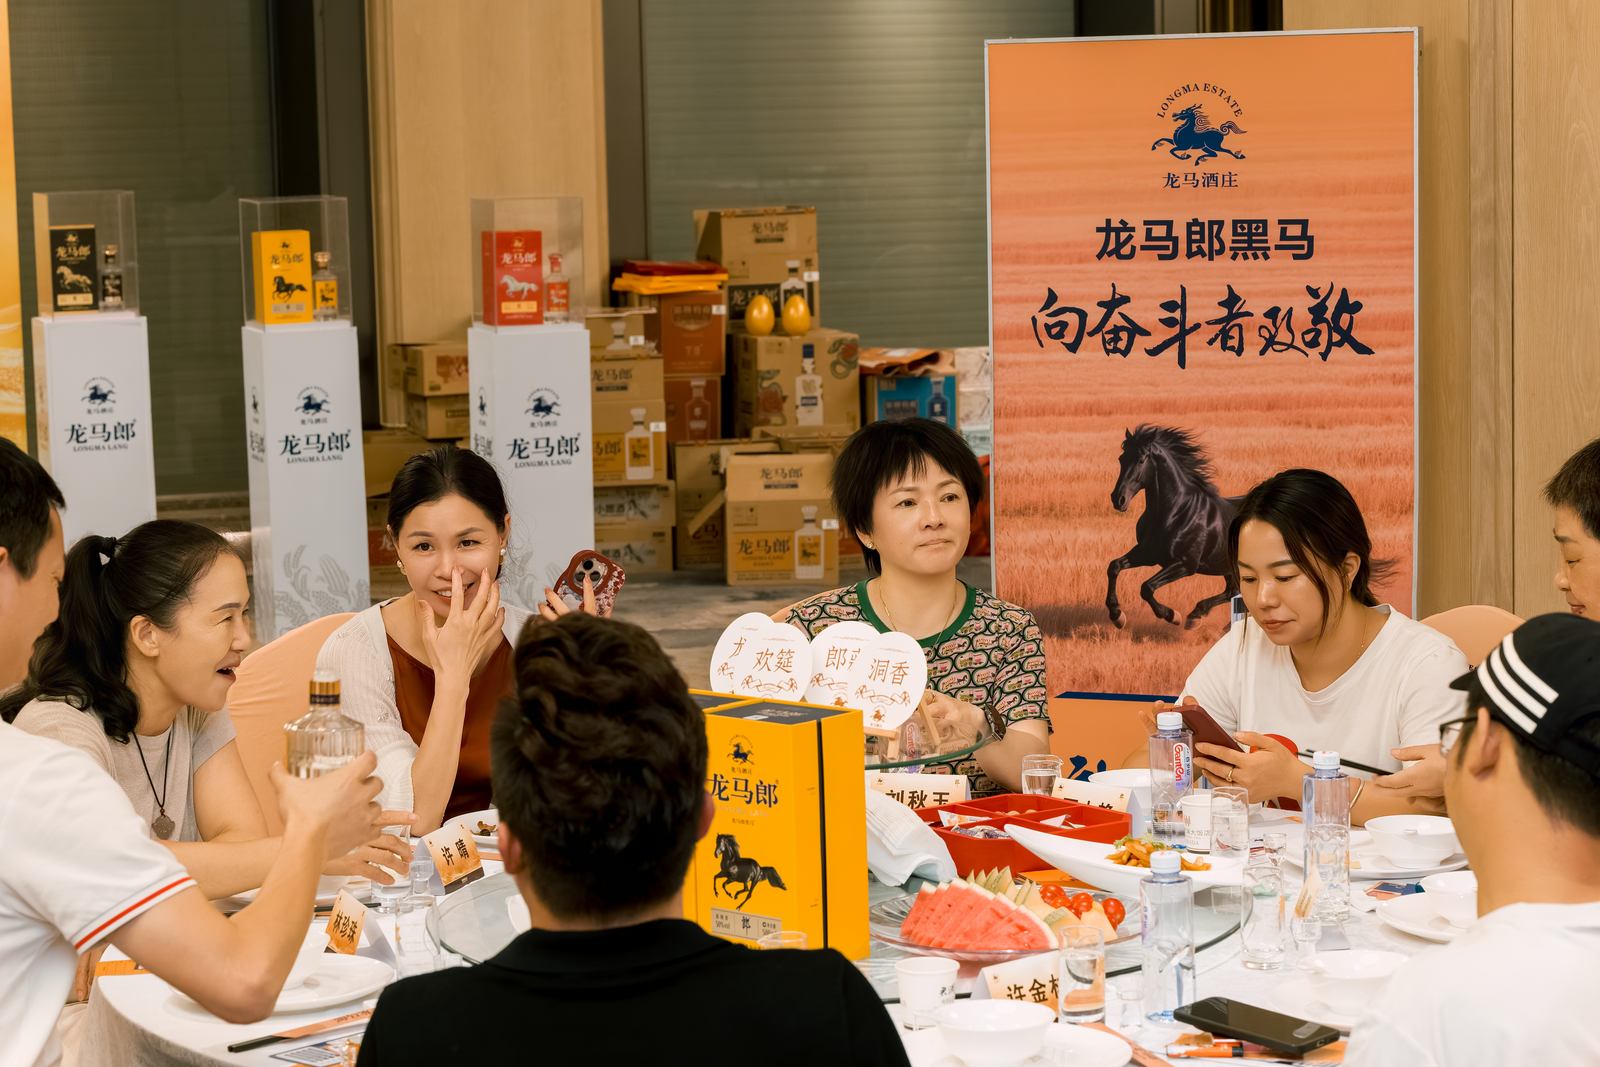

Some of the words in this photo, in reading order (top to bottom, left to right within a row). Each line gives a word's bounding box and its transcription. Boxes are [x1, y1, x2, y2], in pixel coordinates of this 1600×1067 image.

[1157, 83, 1200, 119] LONGMA
[1203, 83, 1243, 118] ESTATE
[1162, 172, 1238, 188] 龙马酒庄
[1095, 218, 1315, 261] 龙马郎黑马
[1031, 281, 1376, 370] 向奋斗者致敬
[64, 421, 135, 444] 龙马郎
[278, 431, 350, 456] 龙马郎
[506, 435, 580, 461] 龙马郎
[514, 460, 549, 468] LONGMA
[551, 458, 572, 466] LANG
[737, 538, 791, 556] 龙马郎
[868, 659, 909, 686] 洞香
[1174, 744, 1184, 782] Ganten
[705, 773, 779, 808] 龙马郎
